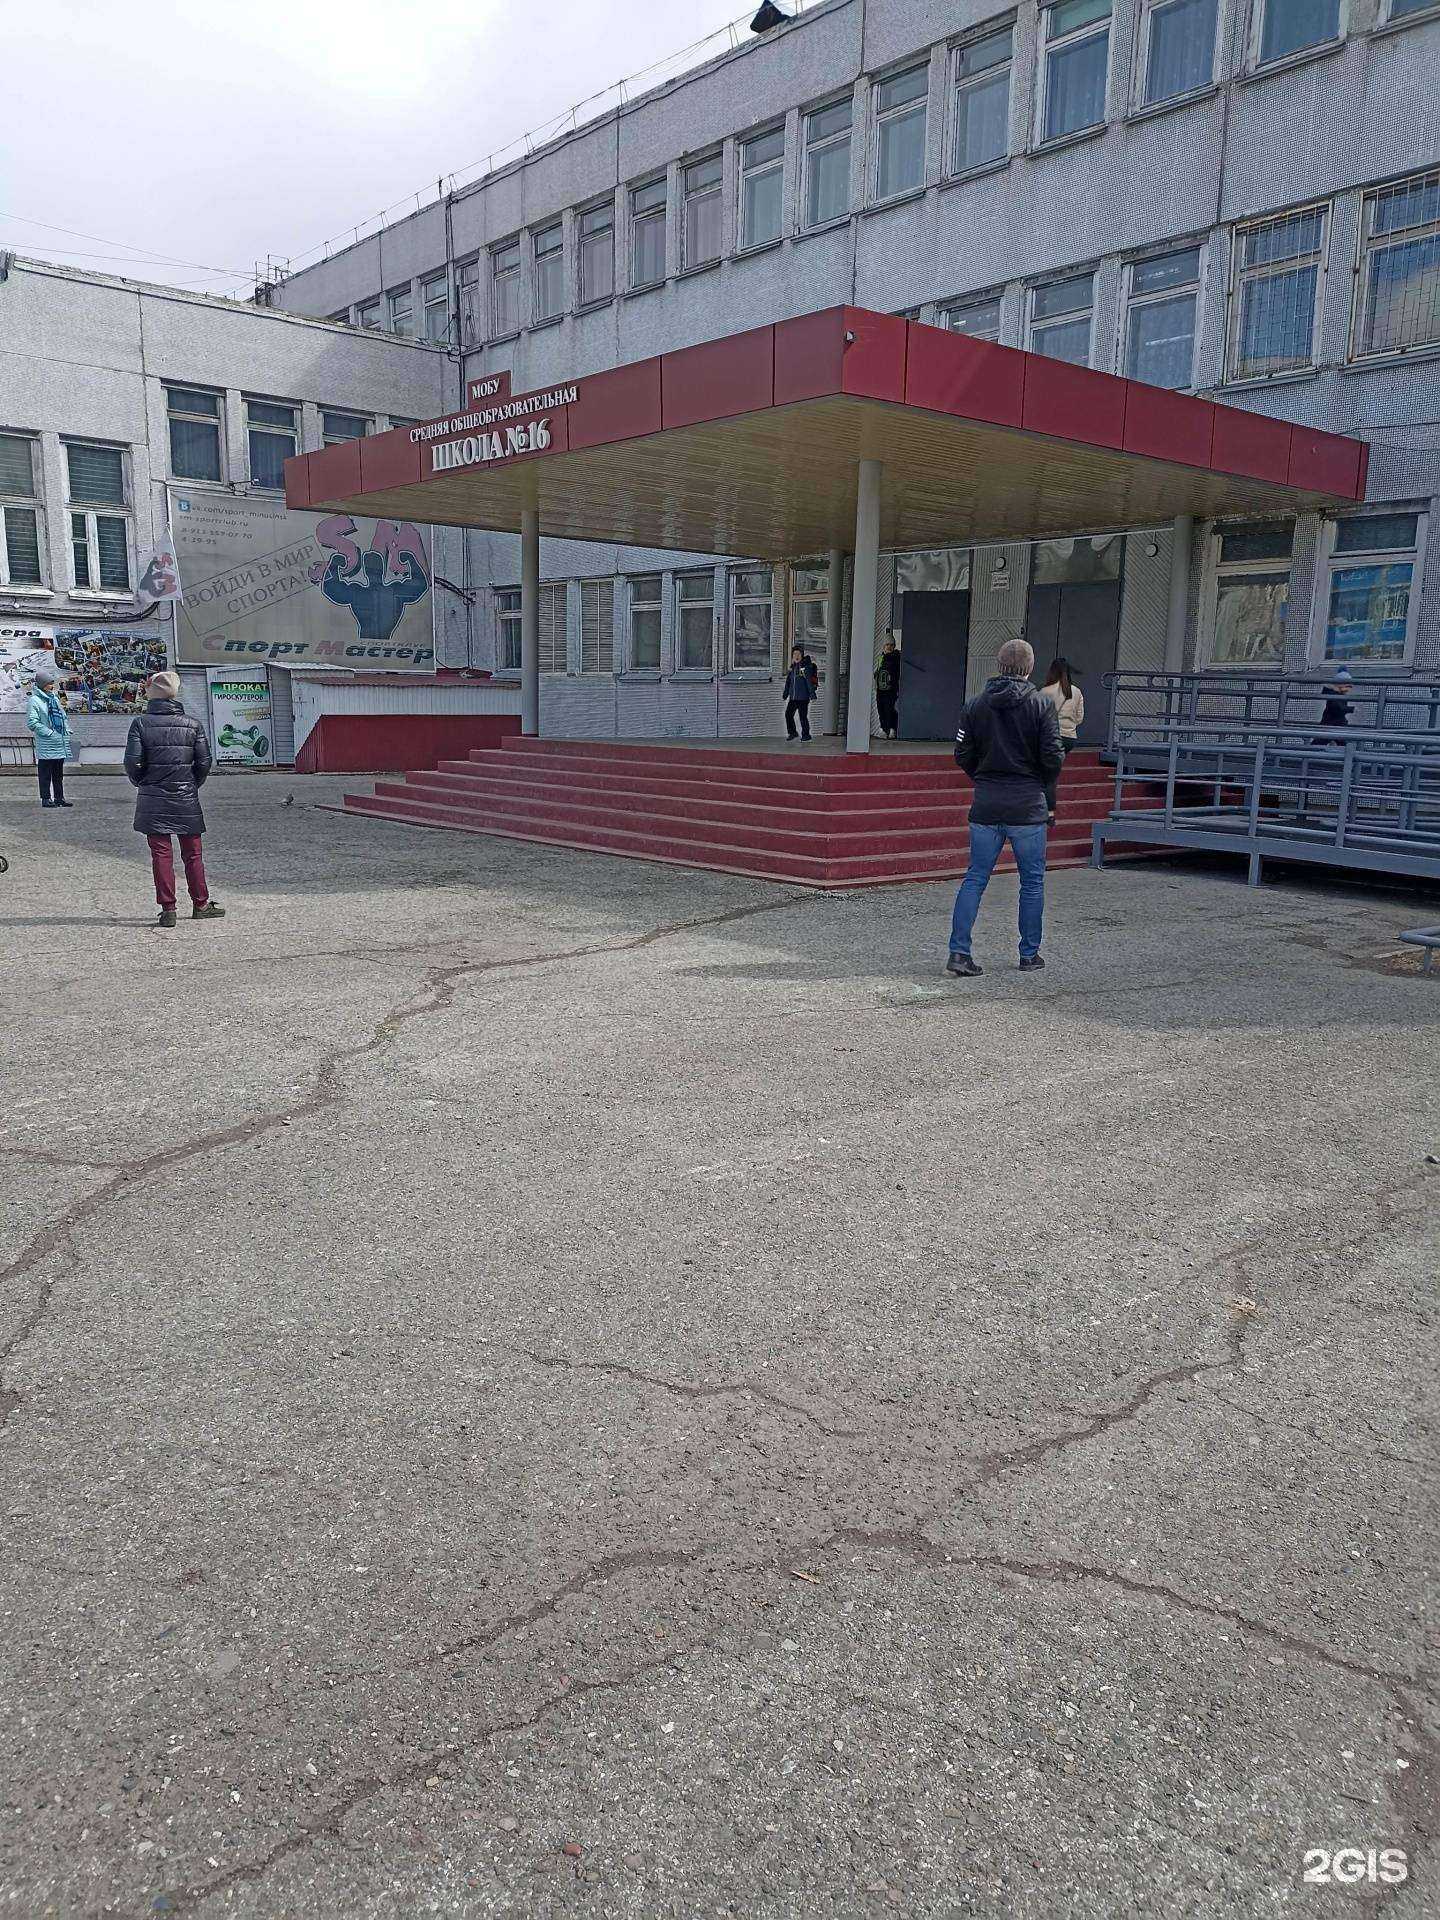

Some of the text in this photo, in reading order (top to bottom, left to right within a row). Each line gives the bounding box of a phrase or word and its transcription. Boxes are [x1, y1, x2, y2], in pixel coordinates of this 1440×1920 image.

[472, 378, 500, 400] МОБУ
[409, 386, 578, 443] СРЕДНЯЯ ОБЩЕОБРАЗОВАТЕЛЬНАЯ
[431, 418, 552, 472] ШКОЛА №16
[184, 545, 314, 609] ВОЙДИ В МИР
[227, 570, 308, 614] СПОРТА!
[0, 629, 41, 637] ера
[202, 635, 434, 663] Спорт Мастер
[222, 683, 268, 692] ПРОКАТ
